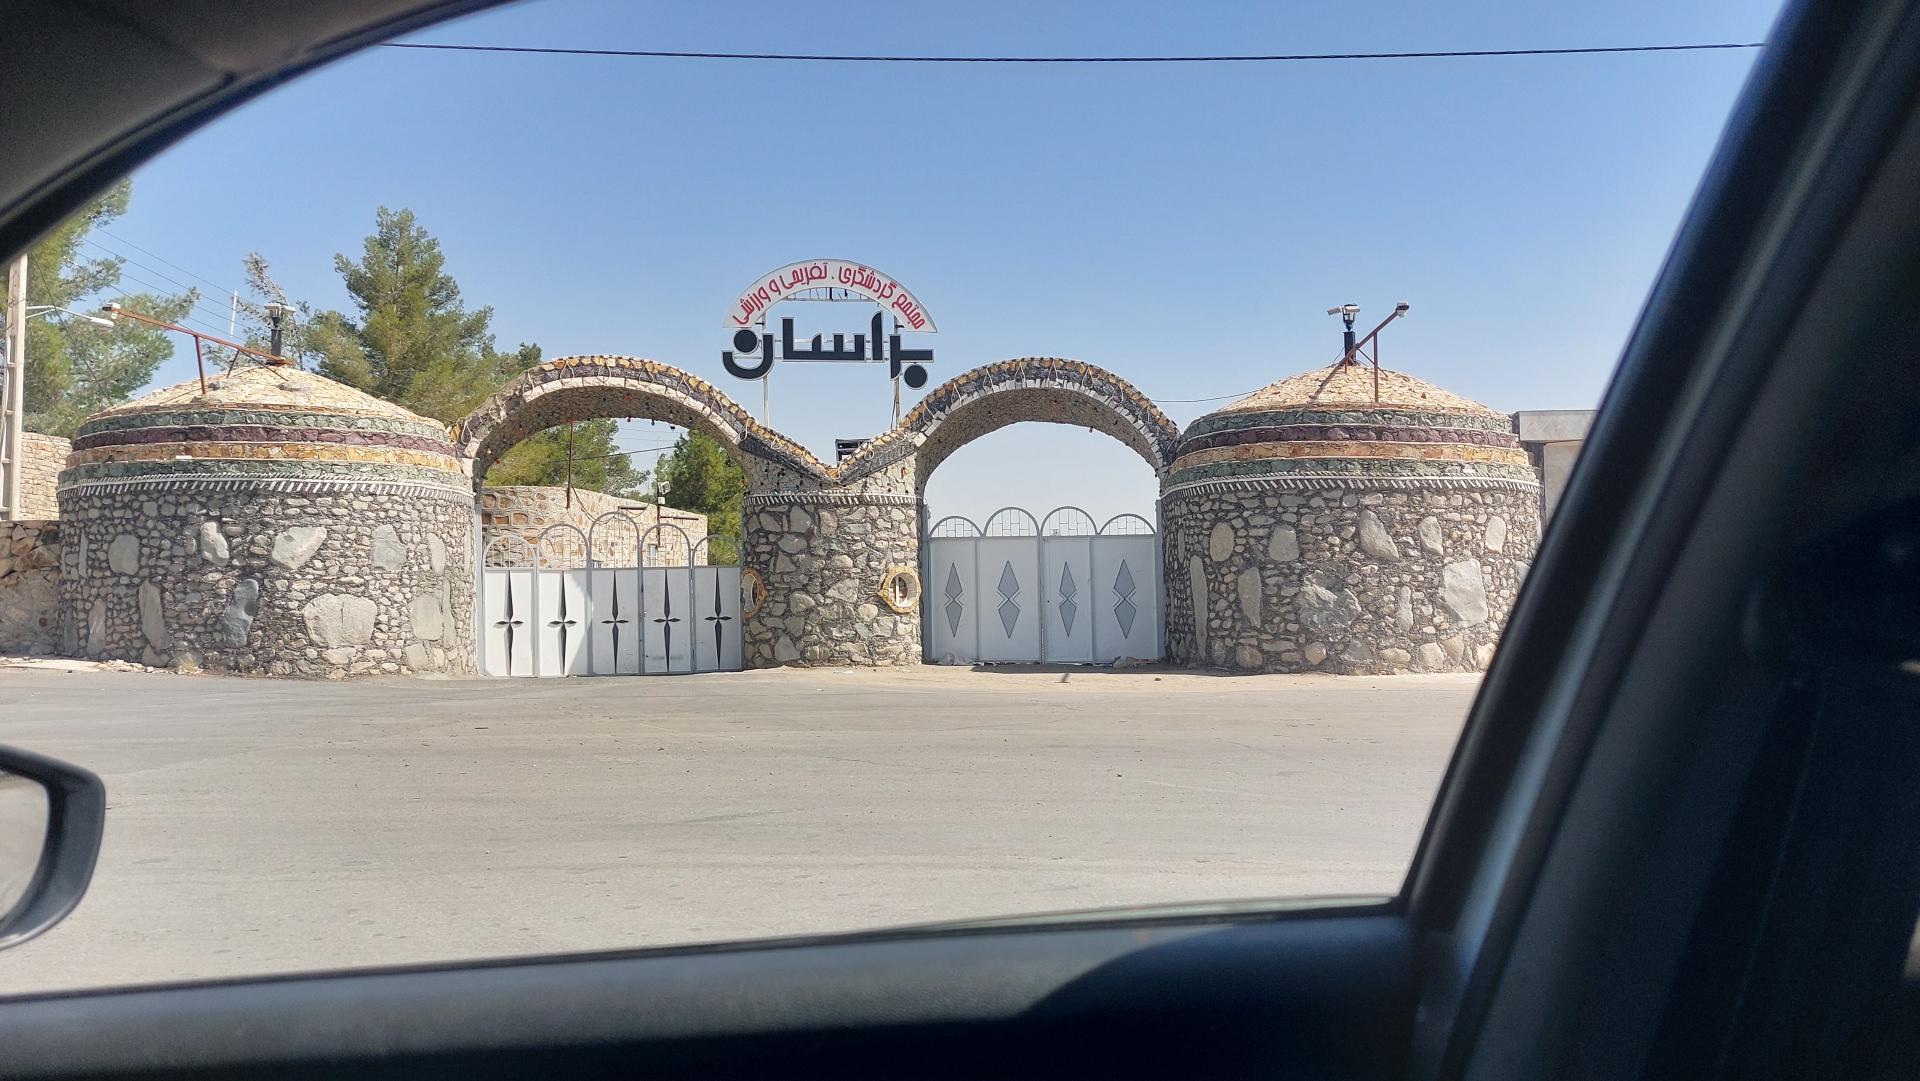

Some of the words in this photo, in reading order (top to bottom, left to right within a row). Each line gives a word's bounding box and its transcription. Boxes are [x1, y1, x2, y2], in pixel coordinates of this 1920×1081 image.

[769, 279, 781, 295] و
[779, 262, 828, 289] تفریحی
[839, 264, 899, 300] گردشگری
[733, 286, 771, 325] ورزشی
[892, 292, 926, 330] مجتمع
[722, 311, 934, 389] براسان
